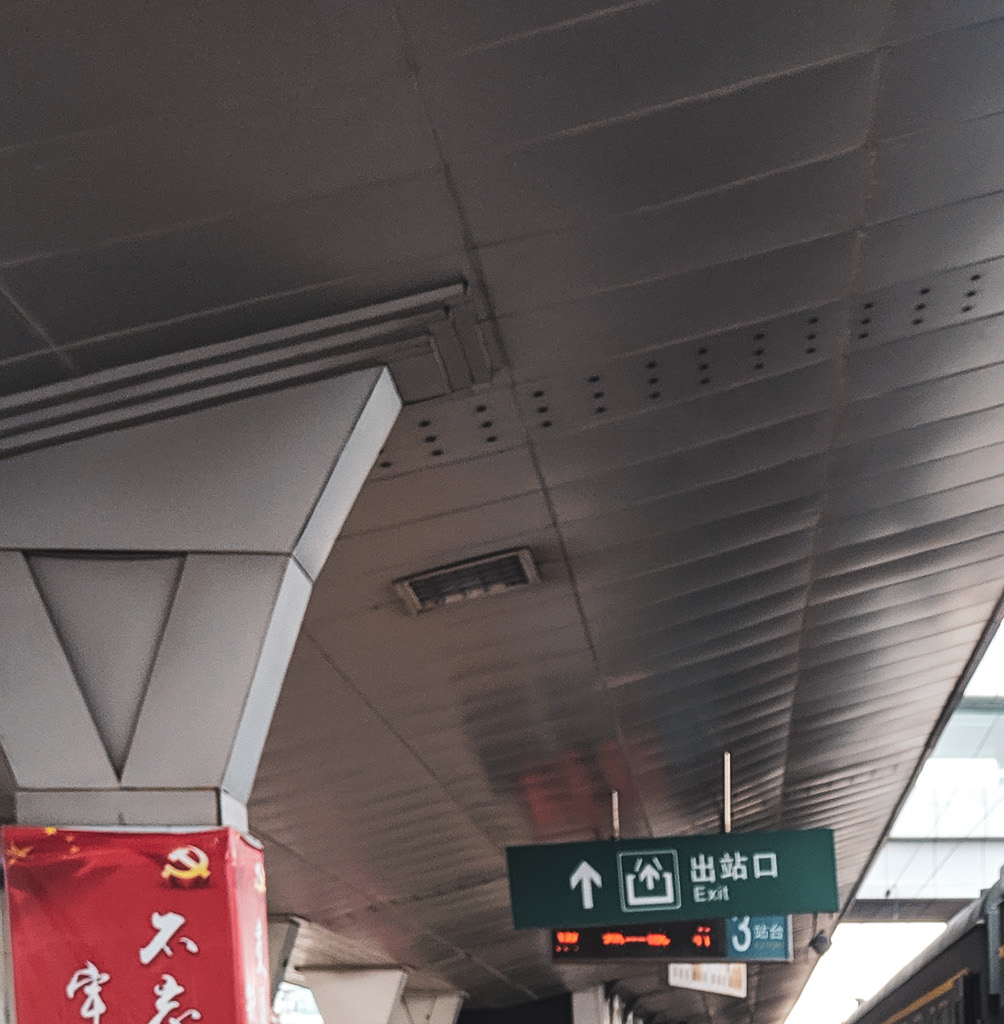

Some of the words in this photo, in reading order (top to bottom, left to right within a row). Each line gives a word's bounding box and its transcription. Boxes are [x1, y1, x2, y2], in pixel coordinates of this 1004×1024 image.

[690, 852, 778, 883] 出站口
[693, 886, 730, 903] Exit
[732, 915, 752, 952] 3
[754, 922, 784, 940] 站台
